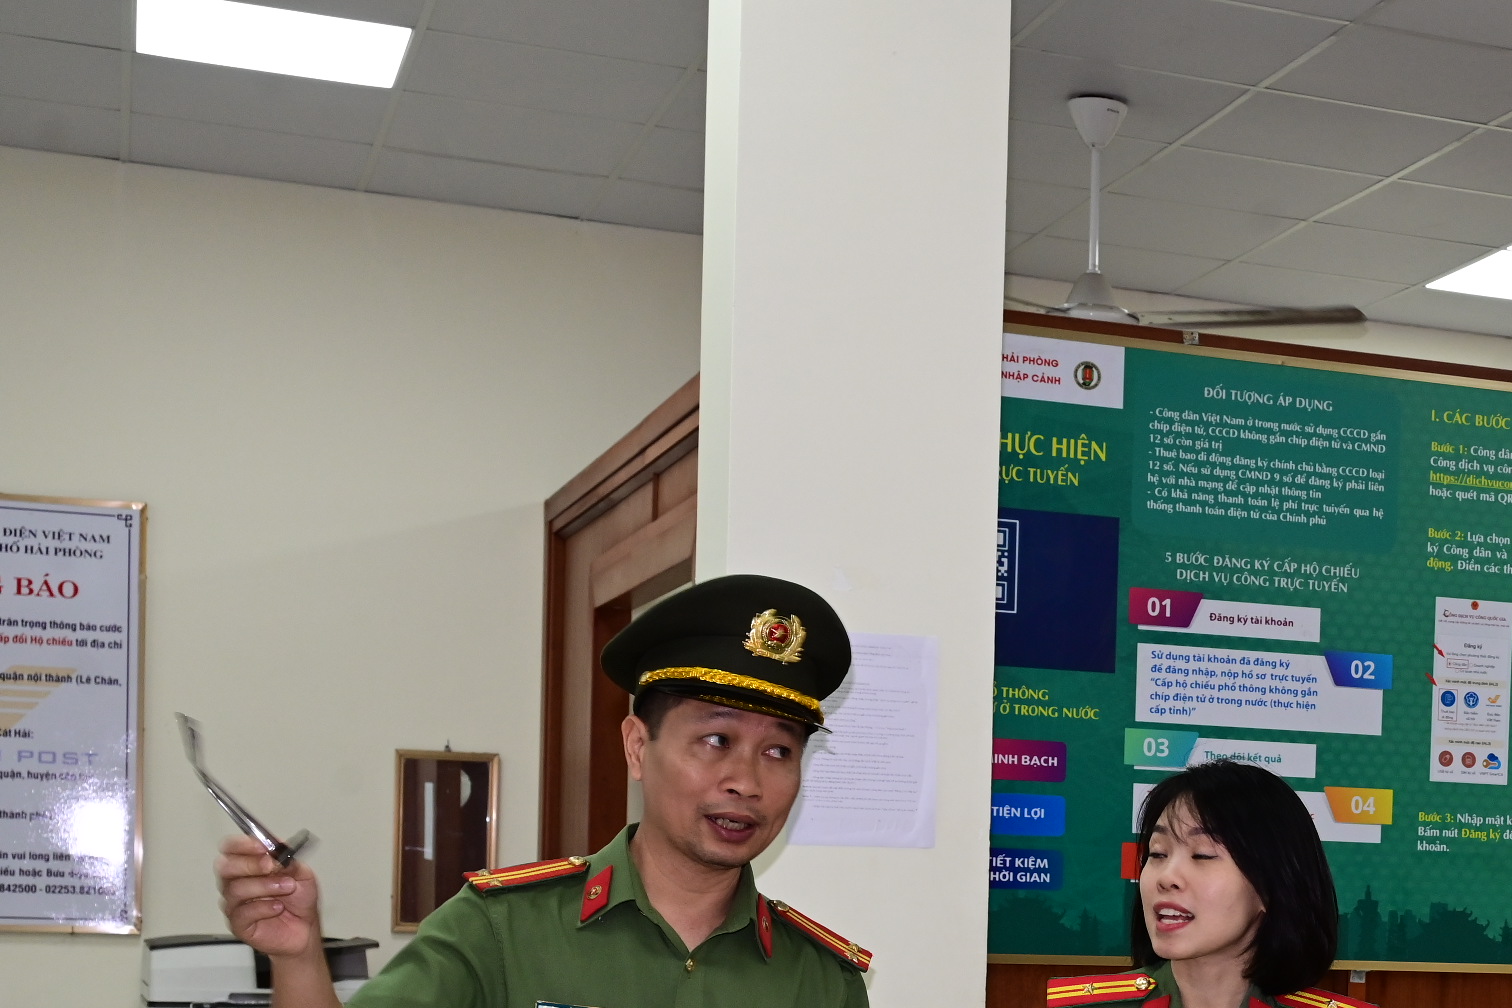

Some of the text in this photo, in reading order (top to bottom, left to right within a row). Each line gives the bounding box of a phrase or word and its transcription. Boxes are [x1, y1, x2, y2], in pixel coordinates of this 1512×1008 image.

[1002, 353, 1059, 368] HẢI PHÒNG
[1001, 370, 1061, 384] NHẬP CẢNH
[1204, 386, 1334, 411] ĐỐI TƯỢNG ÁP DỤNG
[1155, 407, 1387, 441] Công dân Việt Nam ở trong nước sử dụng CCCD gắn
[1431, 411, 1439, 422] I.
[1443, 410, 1470, 425] CÁC
[1475, 414, 1510, 430] BƯỚC
[1051, 434, 1107, 464] HIỆN
[1000, 465, 1079, 486] ỰC TUYẾN
[1429, 487, 1452, 499] hoặc
[1455, 490, 1477, 501] quét
[1479, 492, 1494, 502] mã
[3, 526, 111, 544] ĐIỆN VIỆT NAM
[24, 543, 49, 555] HẢI
[54, 546, 104, 559] PHÒNG
[1165, 551, 1360, 578] 5 BƯỚC ĐĂNG KÝ CẤP HỘ CHIẾU
[14, 574, 79, 598] BÁO
[1176, 570, 1348, 593] DỊCH VỤ CÔNG TRỰC TUYẾN
[1147, 598, 1172, 618] 01
[1209, 614, 1294, 628] Đăng ký tài khoản
[1350, 660, 1375, 679] 02
[1002, 685, 1049, 700] THÔNG
[1000, 700, 1100, 720] Ở TRONG NƯỚC
[1143, 737, 1169, 757] 03
[17, 750, 99, 765] POST
[991, 754, 1058, 768] INH BẠCH
[991, 803, 1045, 821] TIỆN LỢI
[1351, 795, 1376, 814] 04
[1014, 854, 1048, 870] KIỆM
[990, 868, 1050, 883] HỜI GIAN
